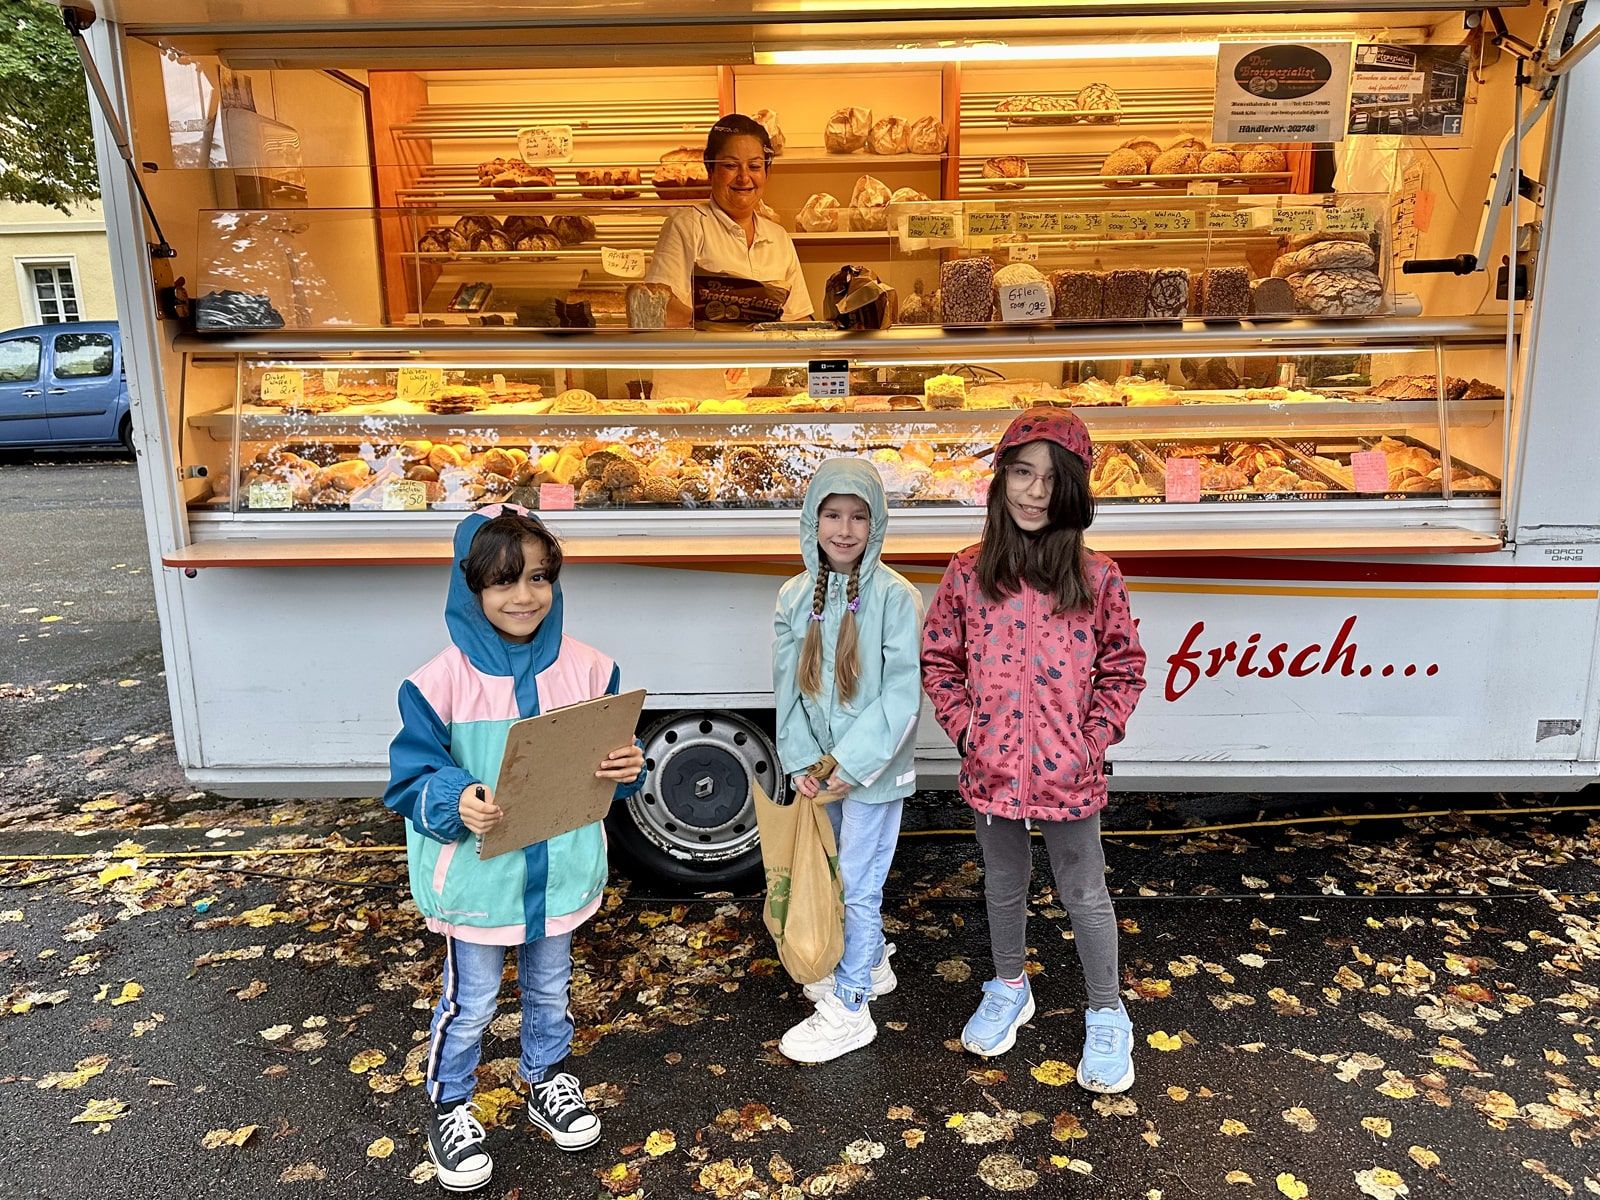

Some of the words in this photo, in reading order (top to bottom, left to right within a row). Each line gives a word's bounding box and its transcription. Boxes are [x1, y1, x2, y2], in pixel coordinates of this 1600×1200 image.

[1249, 55, 1271, 66] Der
[1240, 66, 1316, 79] Brotspezialist
[1287, 124, 1316, 133] 202748
